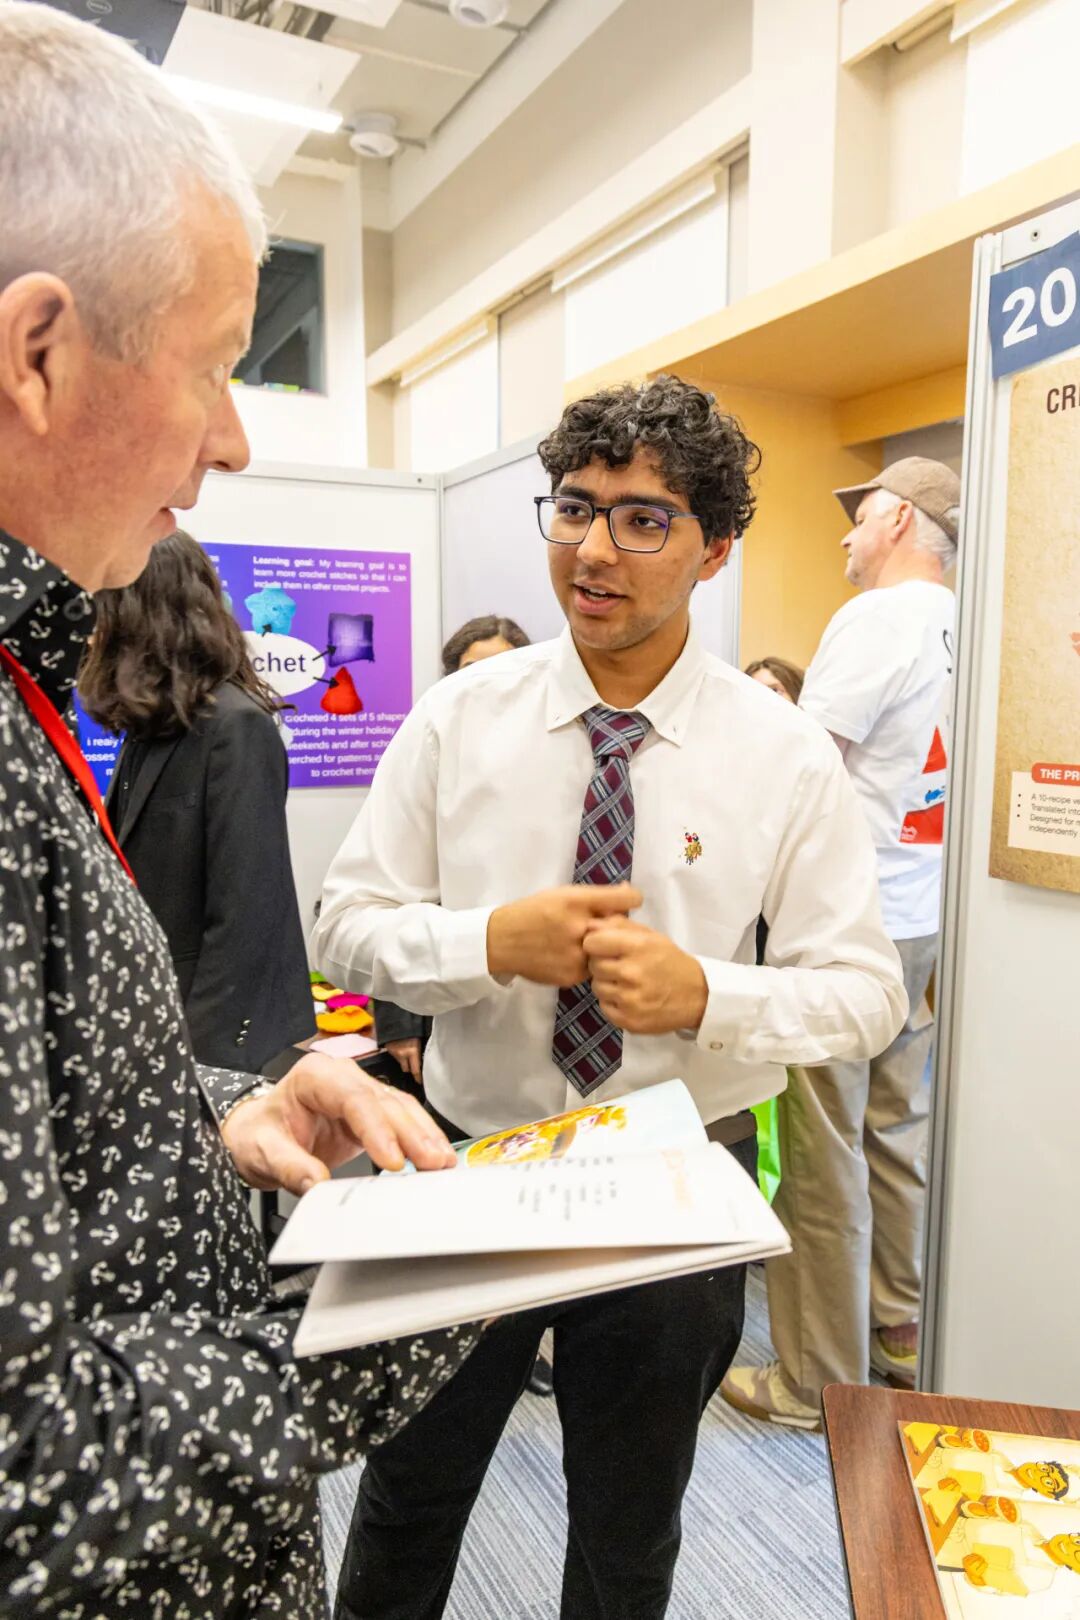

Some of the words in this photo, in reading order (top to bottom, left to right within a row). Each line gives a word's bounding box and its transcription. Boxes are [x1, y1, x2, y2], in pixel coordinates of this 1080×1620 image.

[1002, 267, 1077, 349] 20
[252, 555, 290, 567] Learning
[319, 559, 331, 569] My
[334, 560, 365, 571] learning
[368, 562, 385, 571] goal
[253, 567, 274, 577] learn
[276, 570, 297, 578] more
[298, 570, 327, 579] crochet
[329, 572, 358, 580] stitches
[371, 573, 386, 582] that
[253, 580, 281, 588] include
[282, 581, 303, 590] them
[311, 582, 332, 591] other
[332, 584, 360, 592] crochet
[252, 651, 306, 672] chet
[330, 713, 337, 721] 4
[338, 713, 357, 723] sets
[358, 712, 367, 722] of
[368, 712, 376, 721] 5
[293, 727, 321, 738] during
[321, 727, 337, 736] the
[337, 726, 364, 736] winter
[331, 740, 348, 750] and
[350, 740, 370, 749] after
[323, 754, 336, 763] for
[337, 754, 372, 765] patterns
[310, 768, 320, 777] to
[321, 768, 354, 777] crochet
[1040, 768, 1062, 780] THE
[1064, 770, 1080, 781] PR
[1031, 803, 1067, 814] Translated
[1030, 813, 1063, 825] Designed
[1063, 817, 1074, 825] for
[1029, 824, 1078, 838] independently
